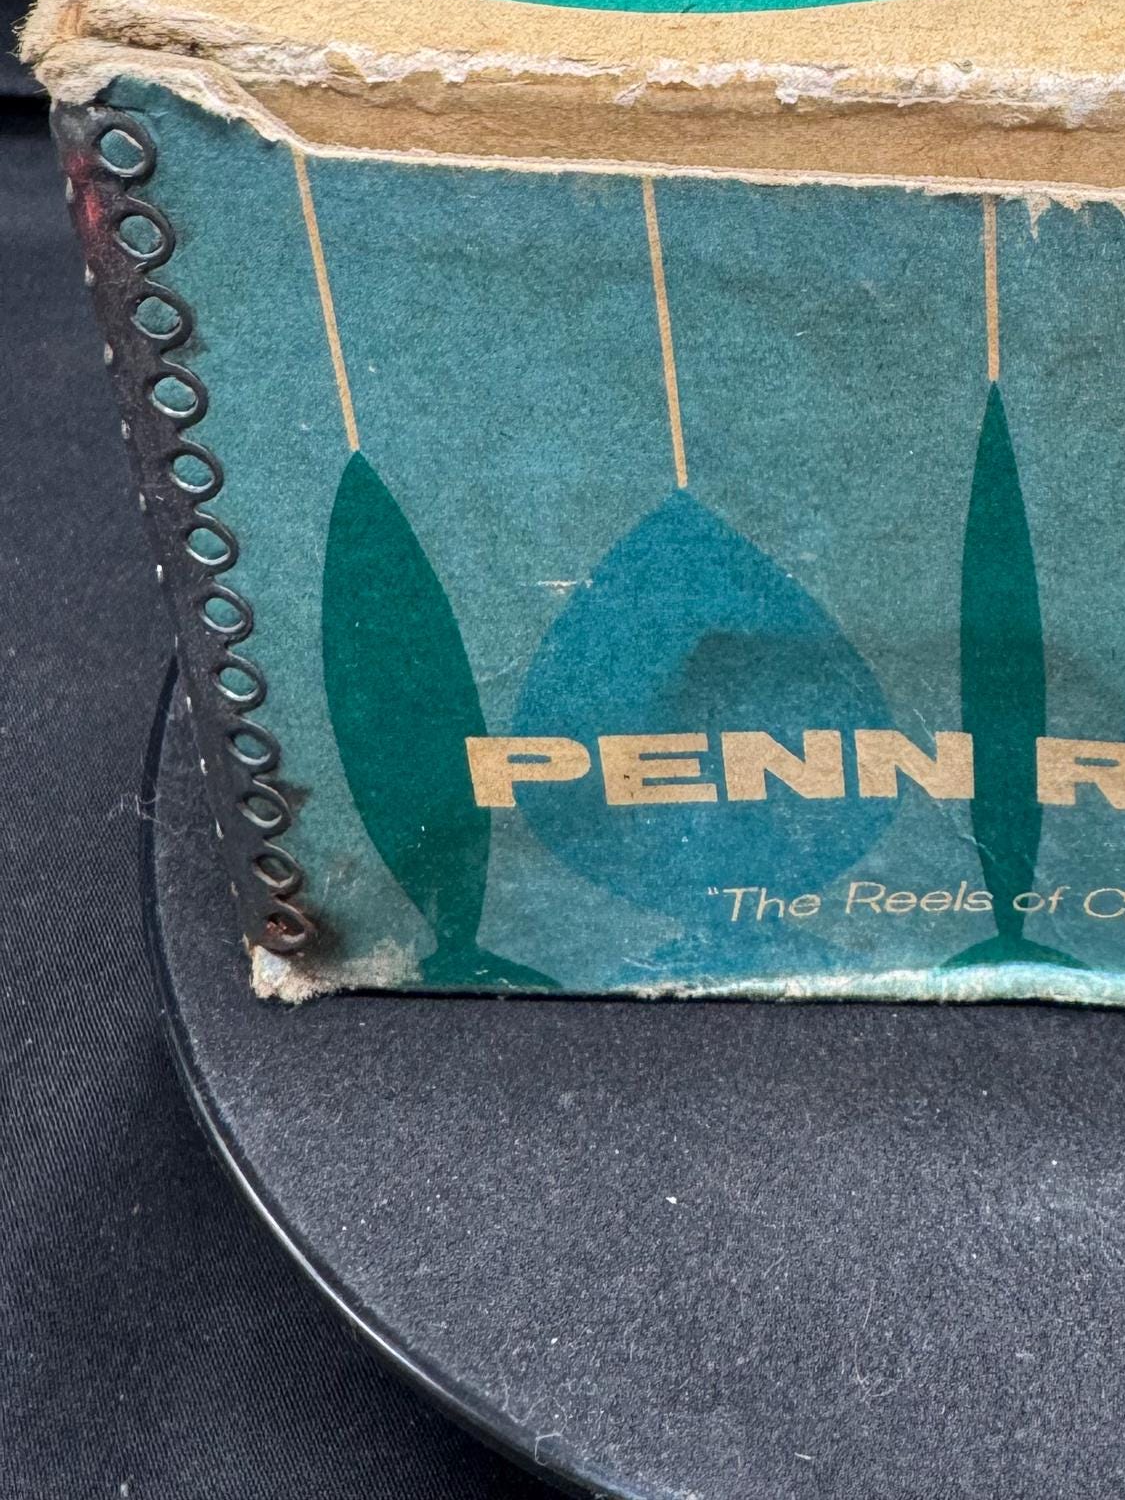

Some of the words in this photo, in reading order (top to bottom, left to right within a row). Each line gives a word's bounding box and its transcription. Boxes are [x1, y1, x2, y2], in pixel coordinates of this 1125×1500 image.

[464, 729, 975, 808] PENN
[707, 885, 819, 921] "The
[846, 880, 994, 915] Reels
[1013, 885, 1072, 914] of
